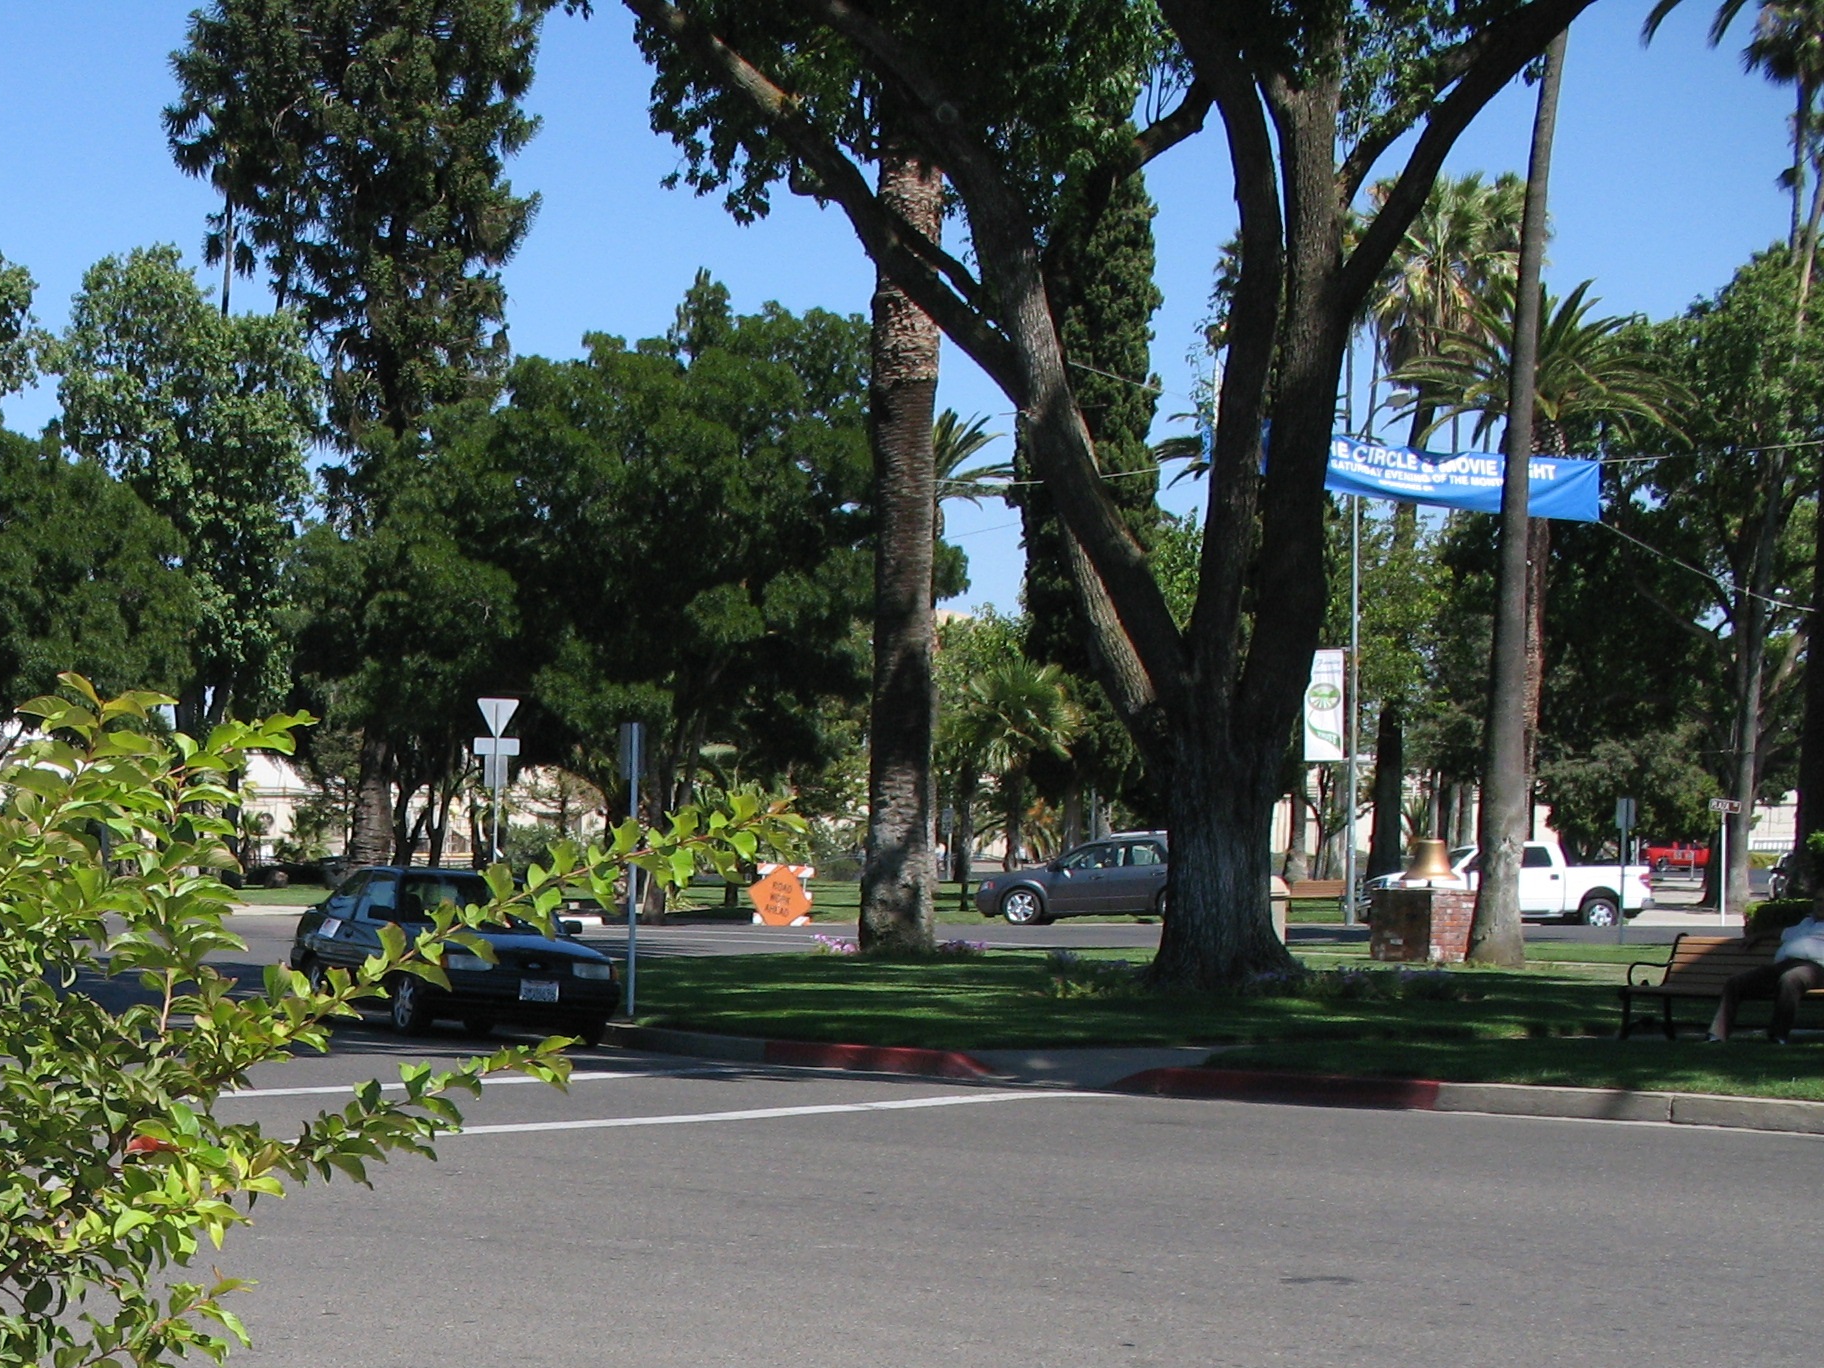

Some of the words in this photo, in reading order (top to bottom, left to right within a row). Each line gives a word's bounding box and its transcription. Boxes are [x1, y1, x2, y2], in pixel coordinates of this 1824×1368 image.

[1353, 445, 1418, 471] CIRCLE
[1331, 459, 1384, 478] SATURDAY
[1432, 473, 1448, 484] OF
[1449, 474, 1470, 485] THE
[772, 881, 793, 894] ROAD
